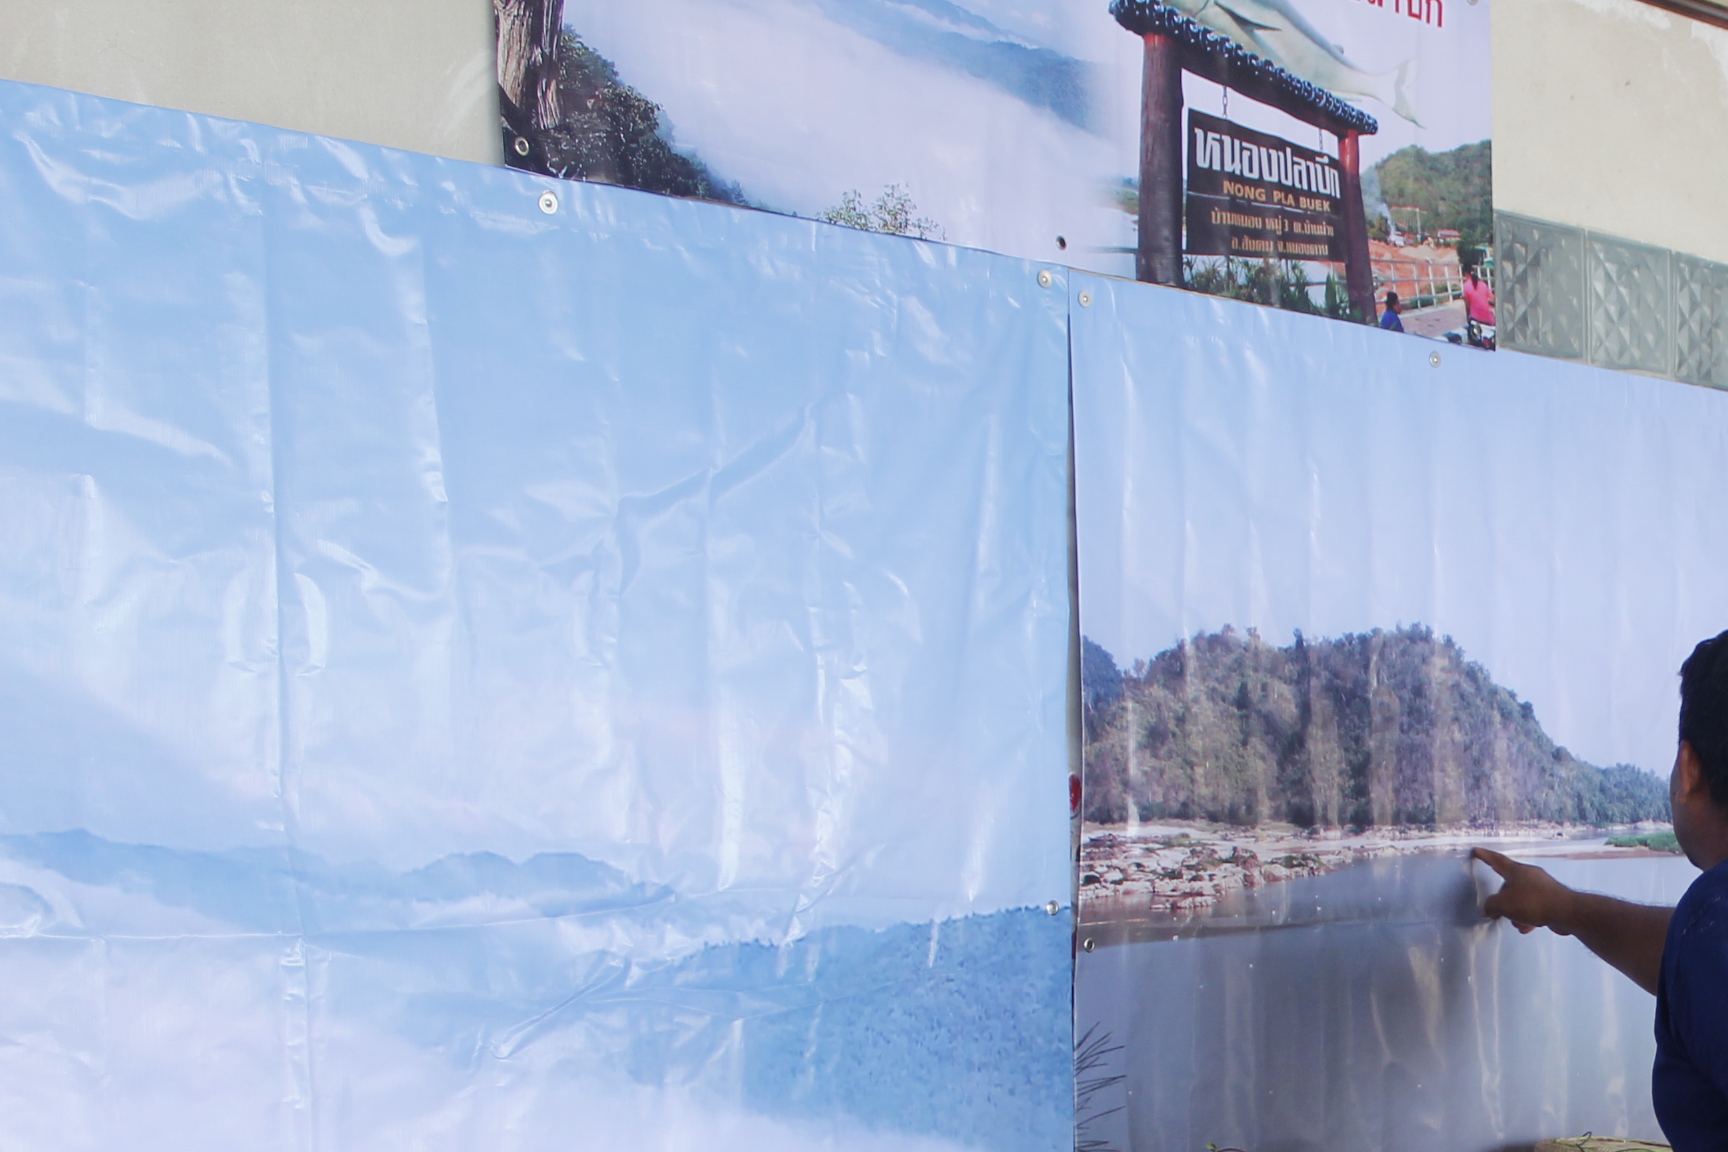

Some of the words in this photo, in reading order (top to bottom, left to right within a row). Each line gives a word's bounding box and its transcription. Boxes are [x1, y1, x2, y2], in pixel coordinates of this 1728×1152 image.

[1194, 127, 1341, 199] หนองปลาบึก
[1223, 180, 1266, 202] NONG
[1273, 190, 1295, 207] PLA
[1300, 196, 1331, 212] BUEK
